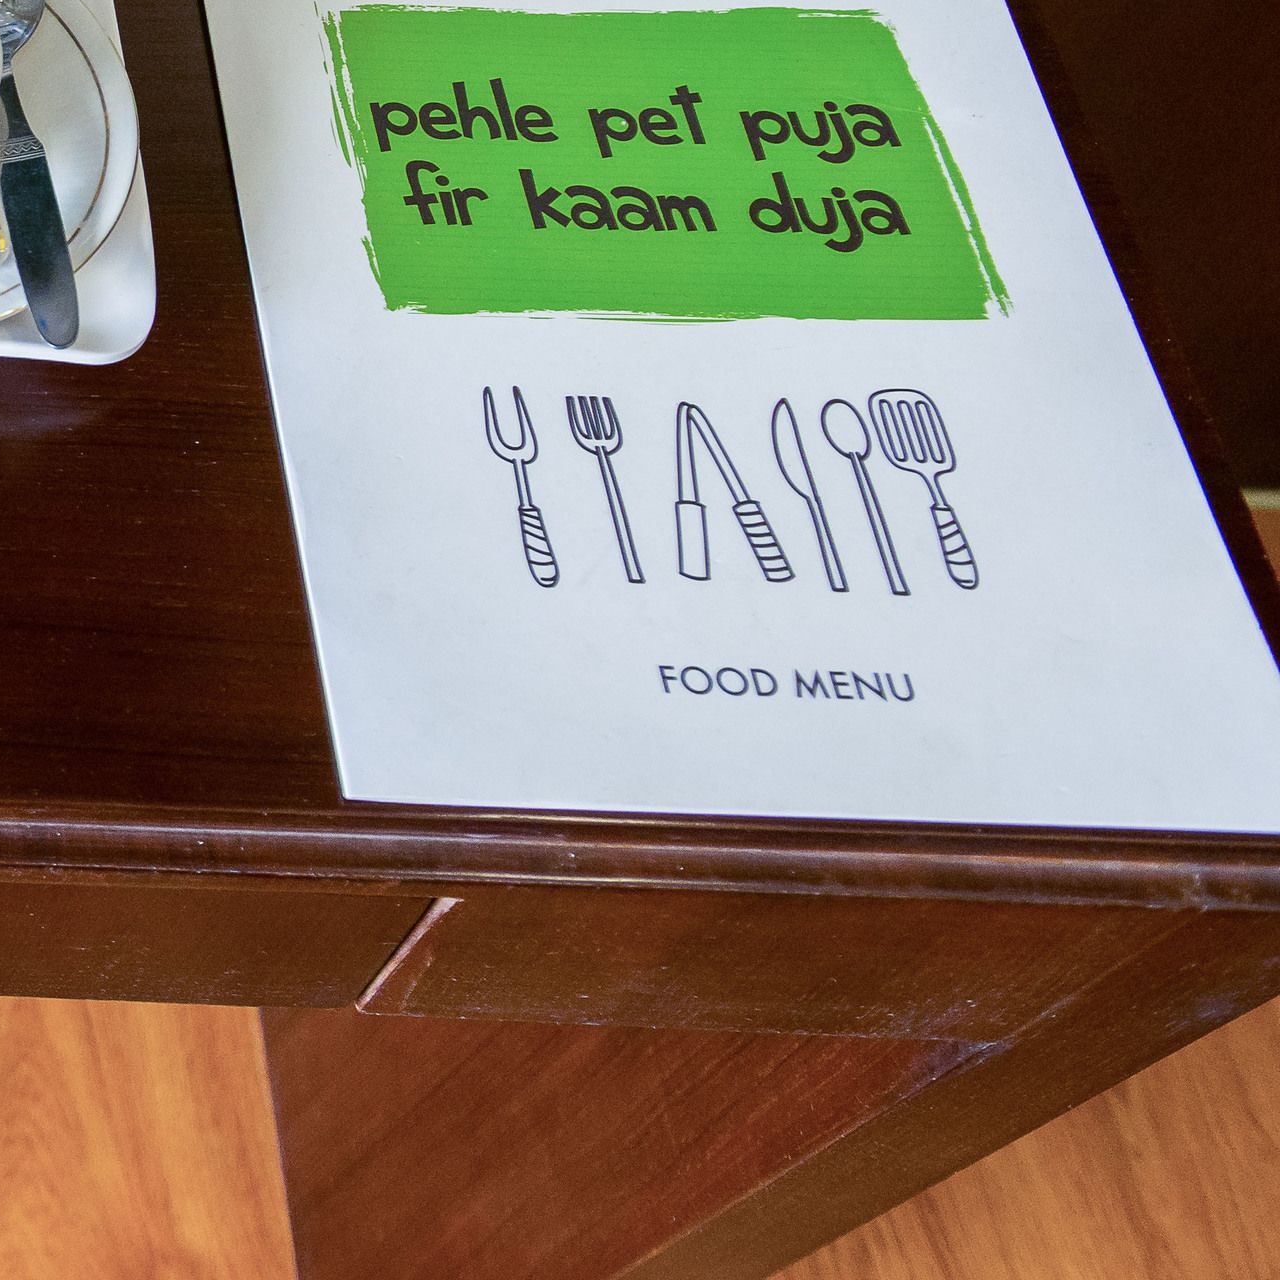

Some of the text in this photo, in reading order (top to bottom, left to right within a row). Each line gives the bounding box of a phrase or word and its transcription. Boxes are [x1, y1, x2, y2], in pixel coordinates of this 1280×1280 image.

[370, 78, 902, 164] pehle pet puja
[403, 160, 912, 252] fir kaam duja
[658, 665, 915, 702] FOOD MENU
